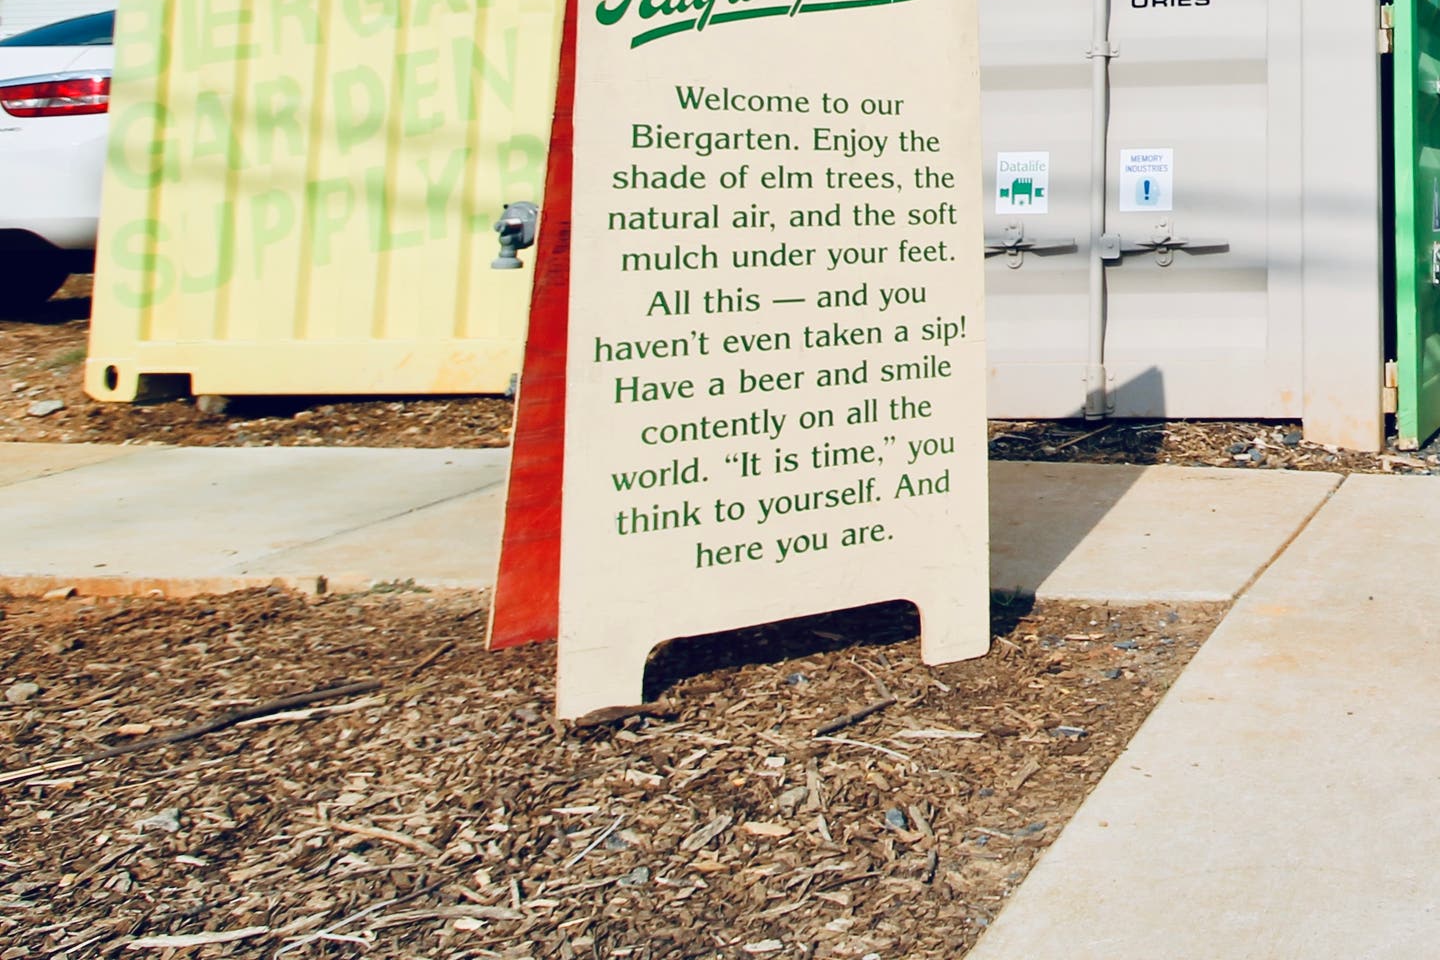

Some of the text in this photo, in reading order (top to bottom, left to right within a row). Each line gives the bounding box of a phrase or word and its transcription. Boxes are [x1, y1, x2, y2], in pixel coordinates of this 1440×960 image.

[107, 26, 518, 190] GARDEN
[675, 85, 904, 116] Welcome to our
[631, 123, 940, 158] Biergarten. Enjoy the
[1000, 159, 1047, 173] Datalife
[1125, 164, 1169, 173] INDUSTRIES
[1130, 154, 1164, 163] MEMORY
[612, 164, 955, 192] shade of elm trees, the
[608, 201, 957, 231] natural air, and the soft
[622, 239, 955, 272] mulch under your feet.
[646, 289, 690, 317] All
[703, 287, 761, 314] this
[816, 282, 868, 309] and
[878, 287, 926, 312] you
[594, 315, 966, 363] haven't even taken a sip!
[615, 354, 952, 404] Have a beer and smile
[641, 395, 932, 445] contently on all the
[611, 435, 954, 492] world. "It is time," you
[616, 468, 950, 536] think to yourself. And
[696, 524, 893, 569] here you are.
